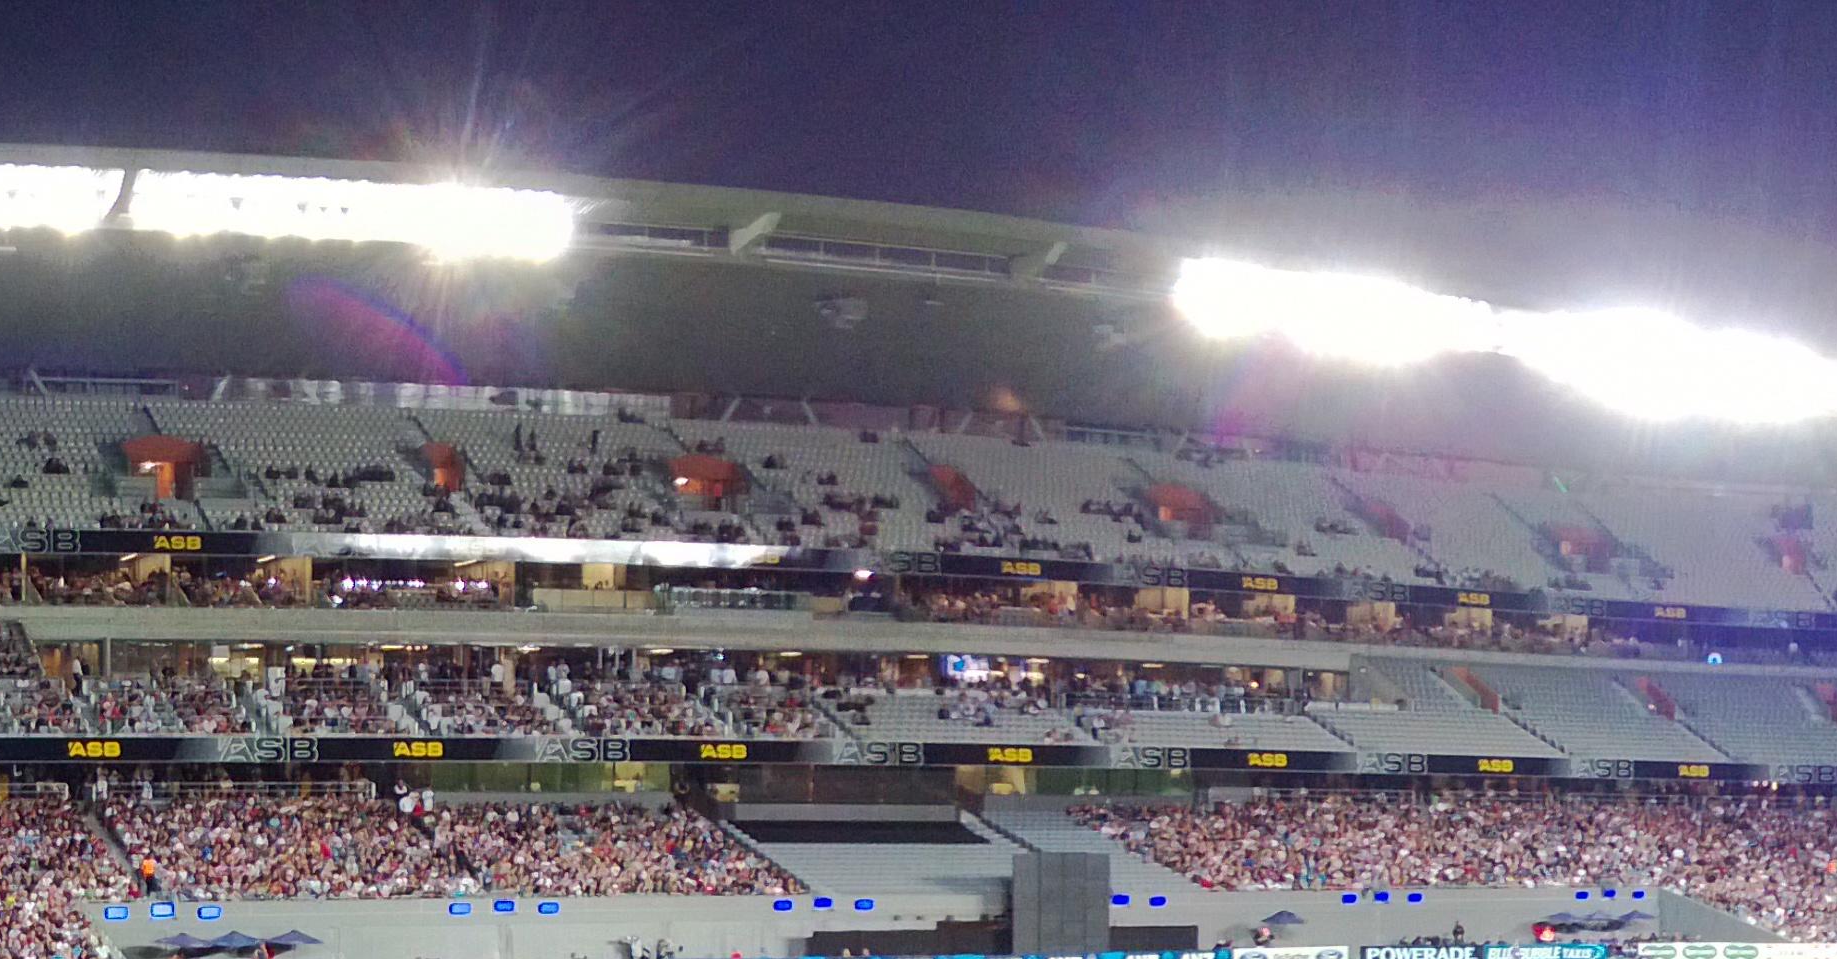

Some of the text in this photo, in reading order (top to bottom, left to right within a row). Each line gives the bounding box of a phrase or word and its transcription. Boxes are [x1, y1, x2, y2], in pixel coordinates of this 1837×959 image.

[154, 535, 202, 551] ASB
[1001, 560, 1042, 577] ASB
[1242, 576, 1279, 591] ASB
[1458, 592, 1491, 606] ASB
[1654, 606, 1687, 618] ASB
[68, 742, 121, 758] ASB
[393, 742, 444, 758] ASB
[700, 743, 747, 759] ASB
[835, 742, 924, 765] ASB
[988, 747, 1032, 762] ASB
[1113, 746, 1192, 770] ASB
[1248, 752, 1288, 768] ASB
[1365, 752, 1428, 774] ASB
[1478, 759, 1514, 773] ASB
[1678, 763, 1710, 778] ASB
